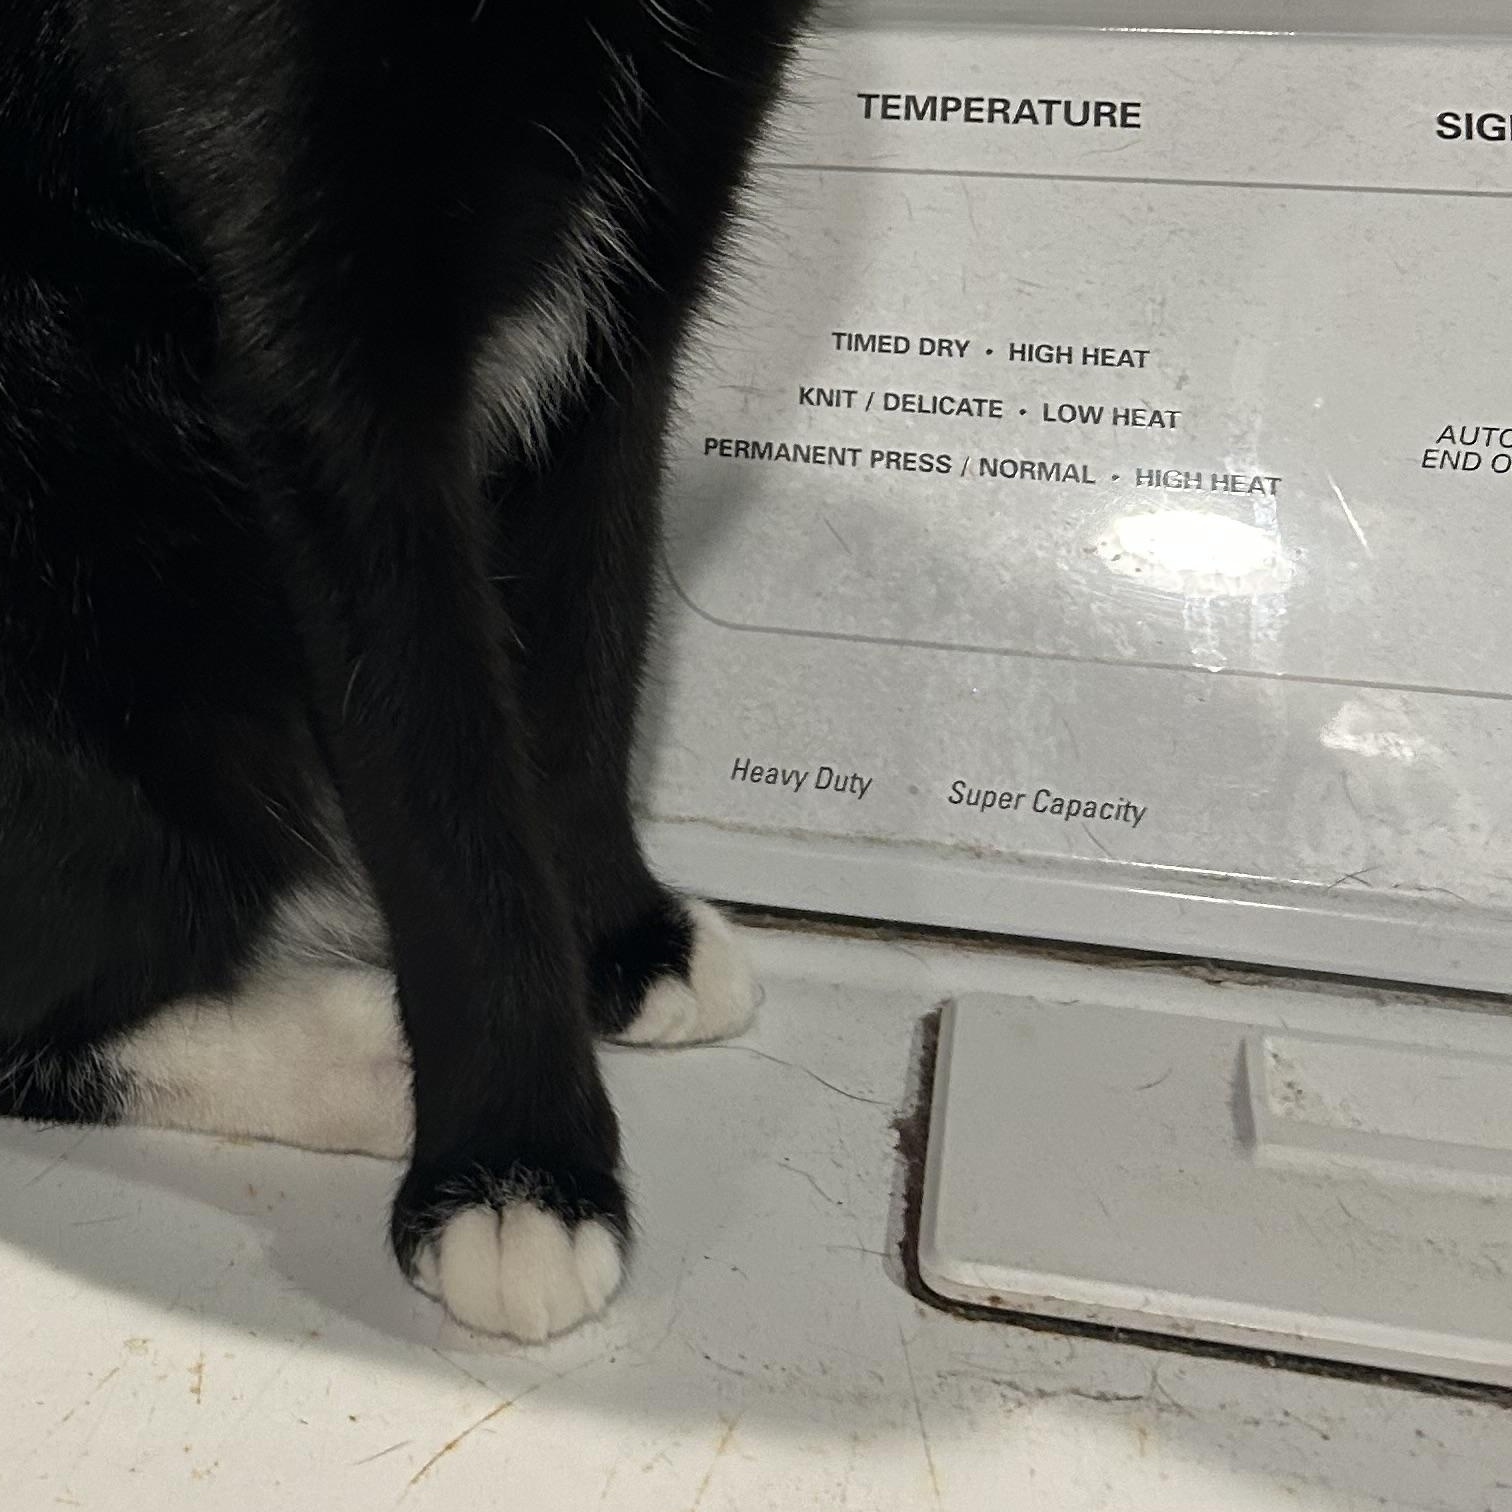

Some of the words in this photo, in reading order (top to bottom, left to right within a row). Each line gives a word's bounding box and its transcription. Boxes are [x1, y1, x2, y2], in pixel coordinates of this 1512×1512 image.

[857, 92, 1143, 130] TEMPERATURE
[1435, 111, 1512, 142] SIG
[832, 332, 910, 355] TIMED
[919, 337, 971, 358] DRY
[1009, 342, 1074, 365] HIGH
[1082, 346, 1151, 369] HEAT
[799, 386, 858, 409] KNIT
[883, 392, 1004, 419] DELICATE
[1043, 402, 1105, 425] LOW
[1112, 407, 1183, 430] HEAT
[1435, 424, 1512, 449] AUTO
[703, 437, 862, 467] PERMANENT
[870, 449, 953, 474] PRESS
[979, 457, 1097, 485] NORMAL
[1136, 467, 1203, 490] HIGH
[1211, 472, 1283, 497] HEAT
[1421, 448, 1482, 472] END
[730, 757, 809, 793] Heavy
[814, 766, 874, 800] Duty
[948, 780, 1027, 814] Super
[1032, 789, 1148, 829] Capacity
